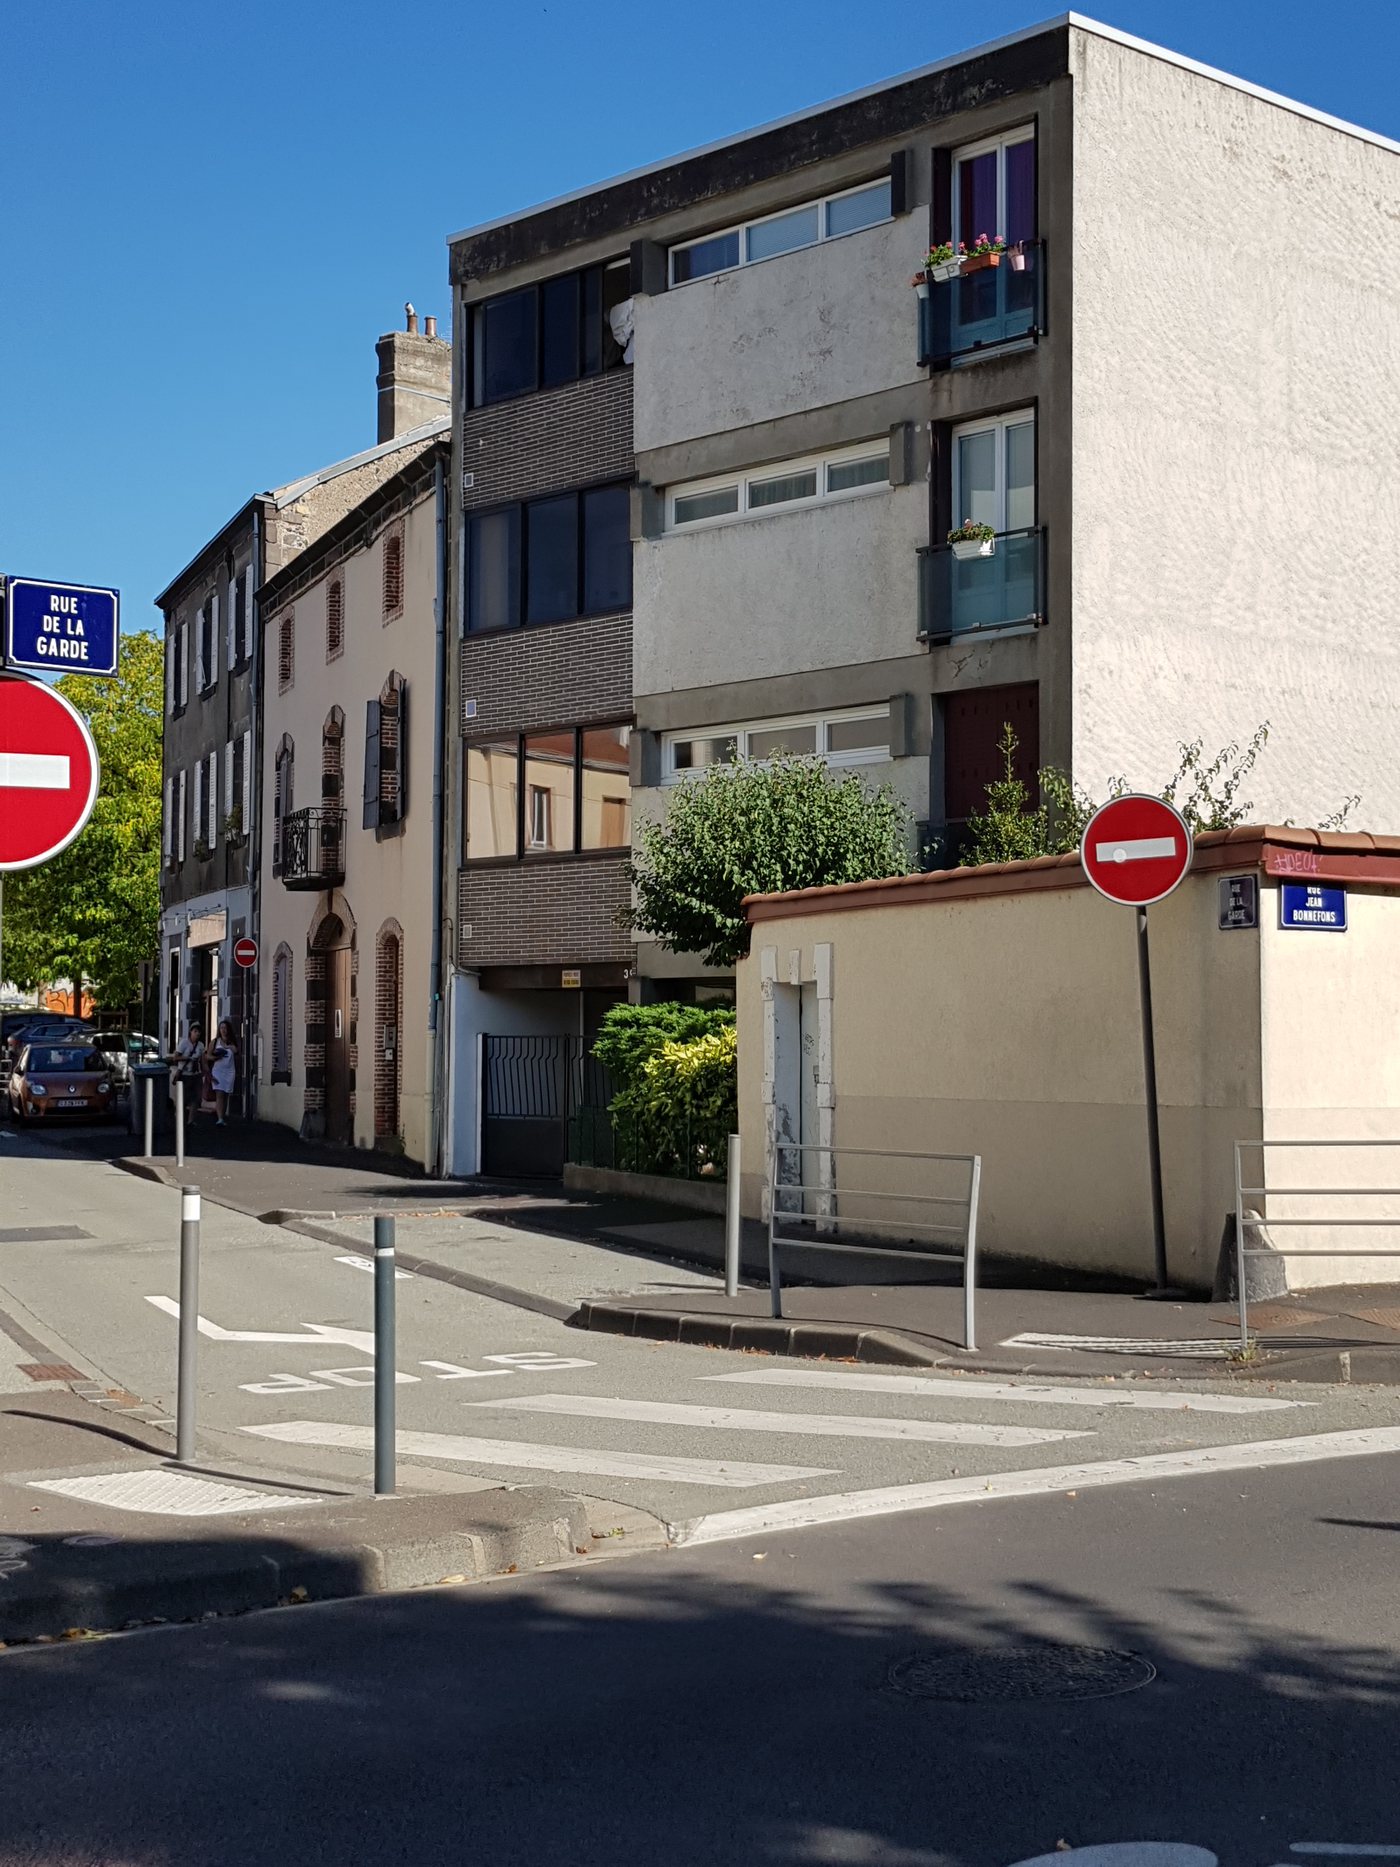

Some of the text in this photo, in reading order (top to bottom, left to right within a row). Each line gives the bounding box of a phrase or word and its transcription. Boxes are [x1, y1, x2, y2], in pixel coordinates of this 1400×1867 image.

[51, 595, 78, 614] RUE
[43, 615, 84, 636] DE LA
[37, 636, 89, 660] GARDE
[1305, 897, 1322, 907] JEAN
[1292, 909, 1336, 922] BONNEFONS
